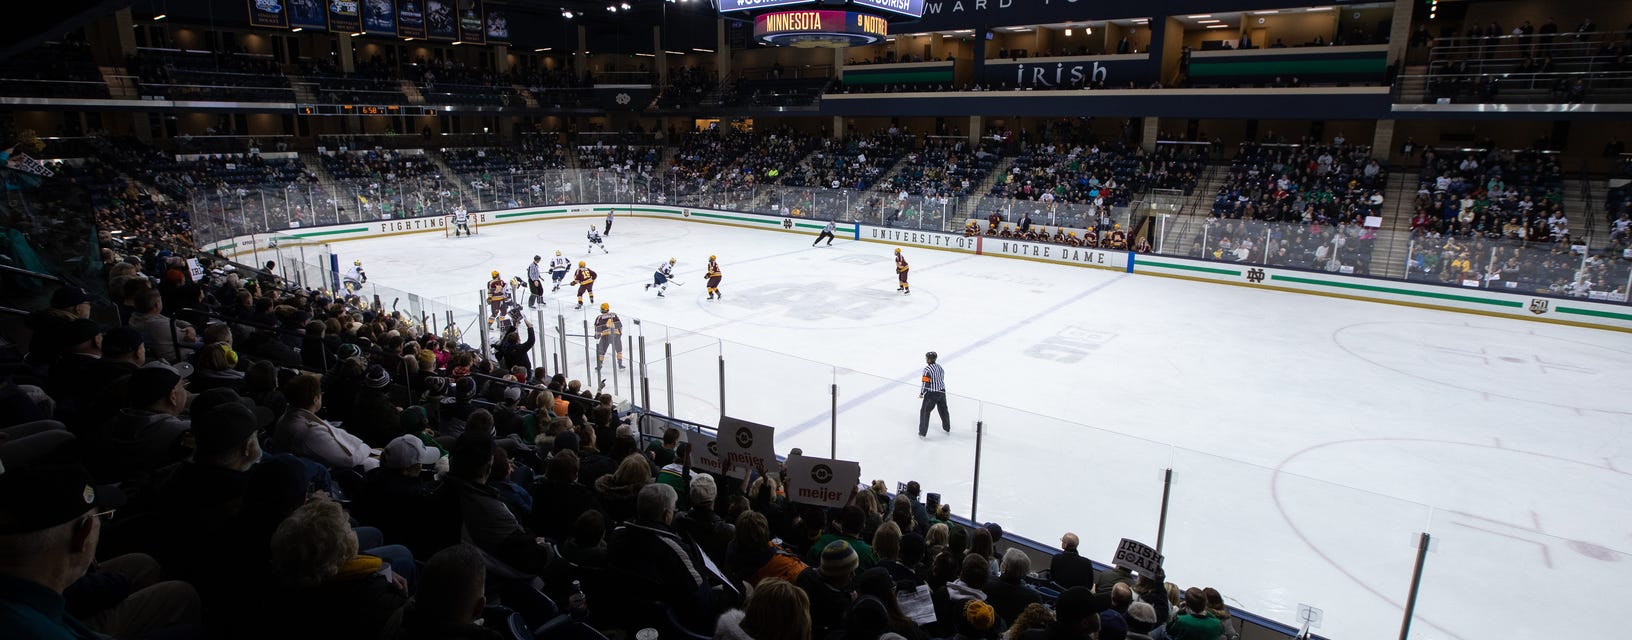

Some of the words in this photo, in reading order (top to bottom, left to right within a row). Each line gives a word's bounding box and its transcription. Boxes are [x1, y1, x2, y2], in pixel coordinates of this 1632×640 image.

[766, 12, 821, 32] MINNESOTA
[858, 15, 863, 26] 9
[381, 218, 444, 232] FIGHTING
[872, 228, 950, 246] UNIVERSITY
[959, 237, 974, 249] OF
[1002, 242, 1050, 257] NOTRE
[1062, 248, 1105, 264] DAME
[700, 456, 737, 472] meir
[727, 451, 765, 467] meijer
[798, 487, 843, 502] meijer
[1120, 540, 1161, 564] IRISH
